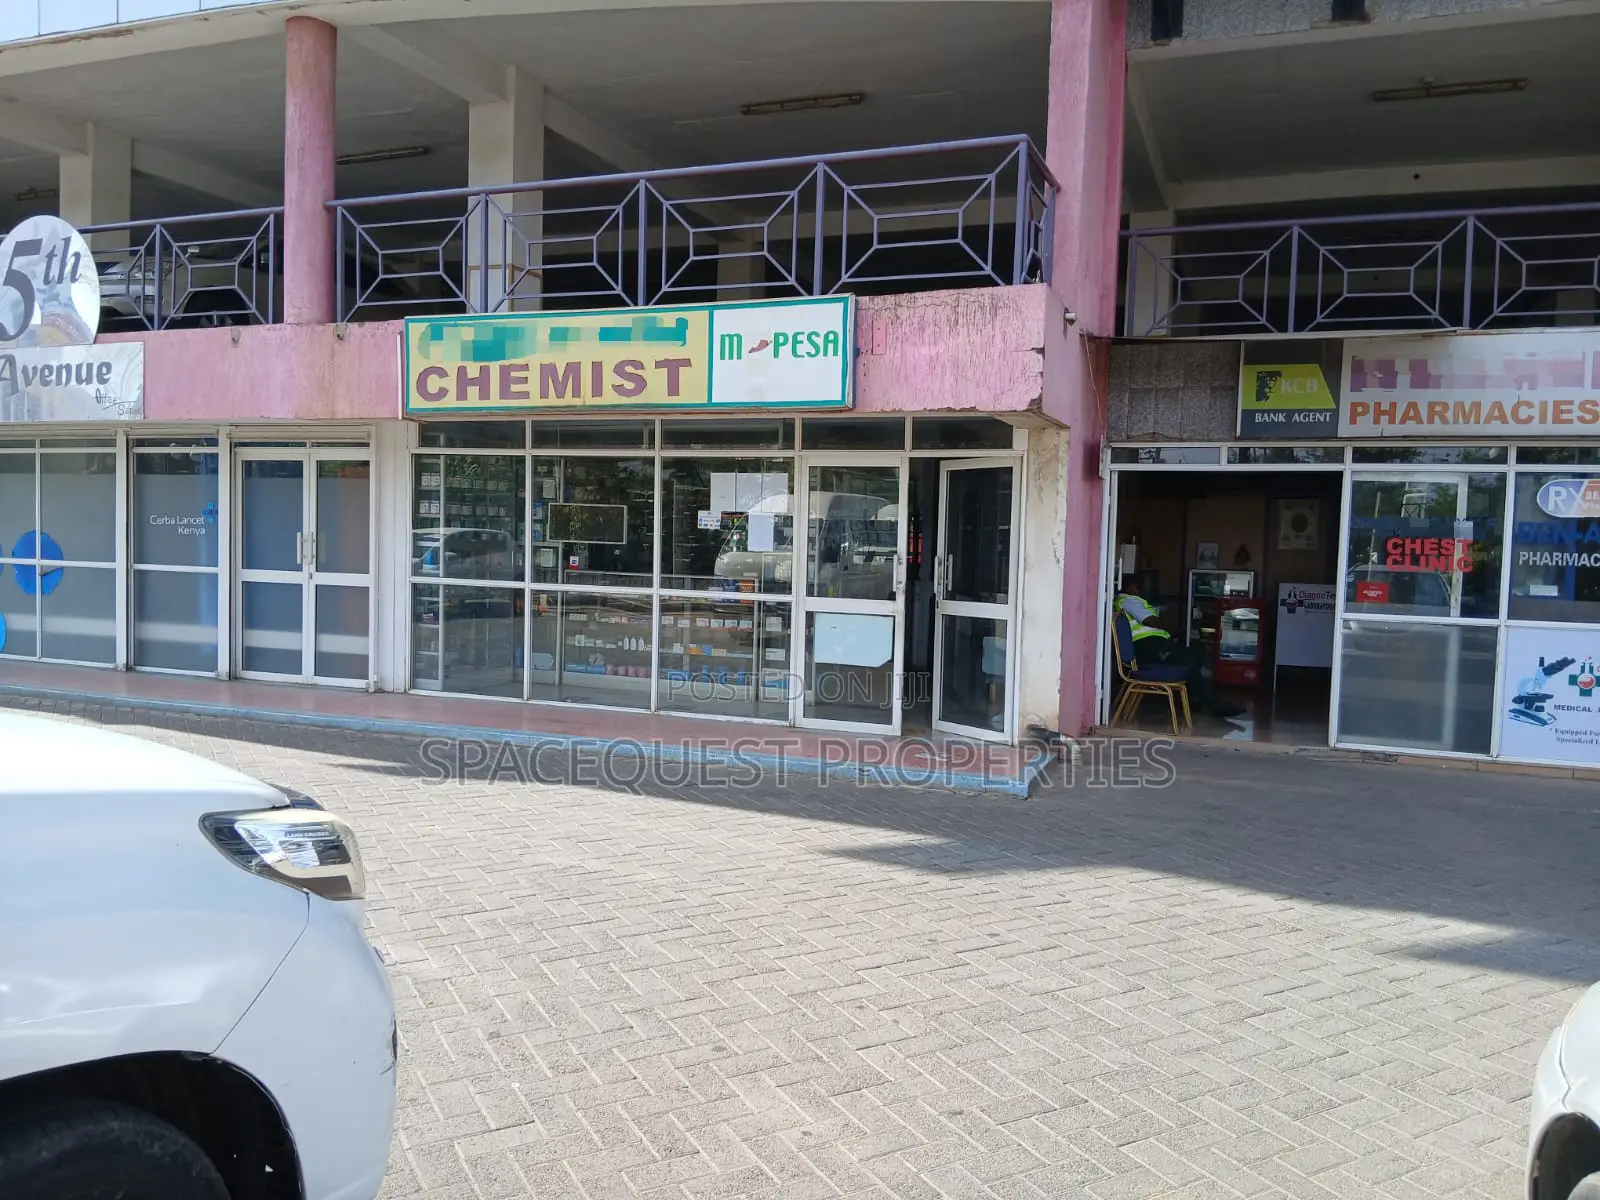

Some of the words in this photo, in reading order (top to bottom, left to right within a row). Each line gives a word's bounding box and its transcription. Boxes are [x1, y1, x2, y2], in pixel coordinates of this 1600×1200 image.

[0, 235, 82, 341] 5th
[773, 330, 840, 359] PESA
[0, 353, 113, 397] Avenue
[415, 358, 692, 402] CHEMIST
[1281, 377, 1318, 395] KCB
[1255, 412, 1286, 423] BANK
[1292, 411, 1332, 423] AGENT
[1348, 400, 1600, 425] PHARMACIES
[149, 514, 175, 525] Cerba
[176, 515, 205, 525] Lancet
[178, 526, 206, 536] Kenya
[1386, 537, 1473, 555] CHEST
[1386, 555, 1473, 573] CLINIC
[1518, 551, 1600, 567] PHARMAC
[1553, 704, 1592, 713] MEDICAL
